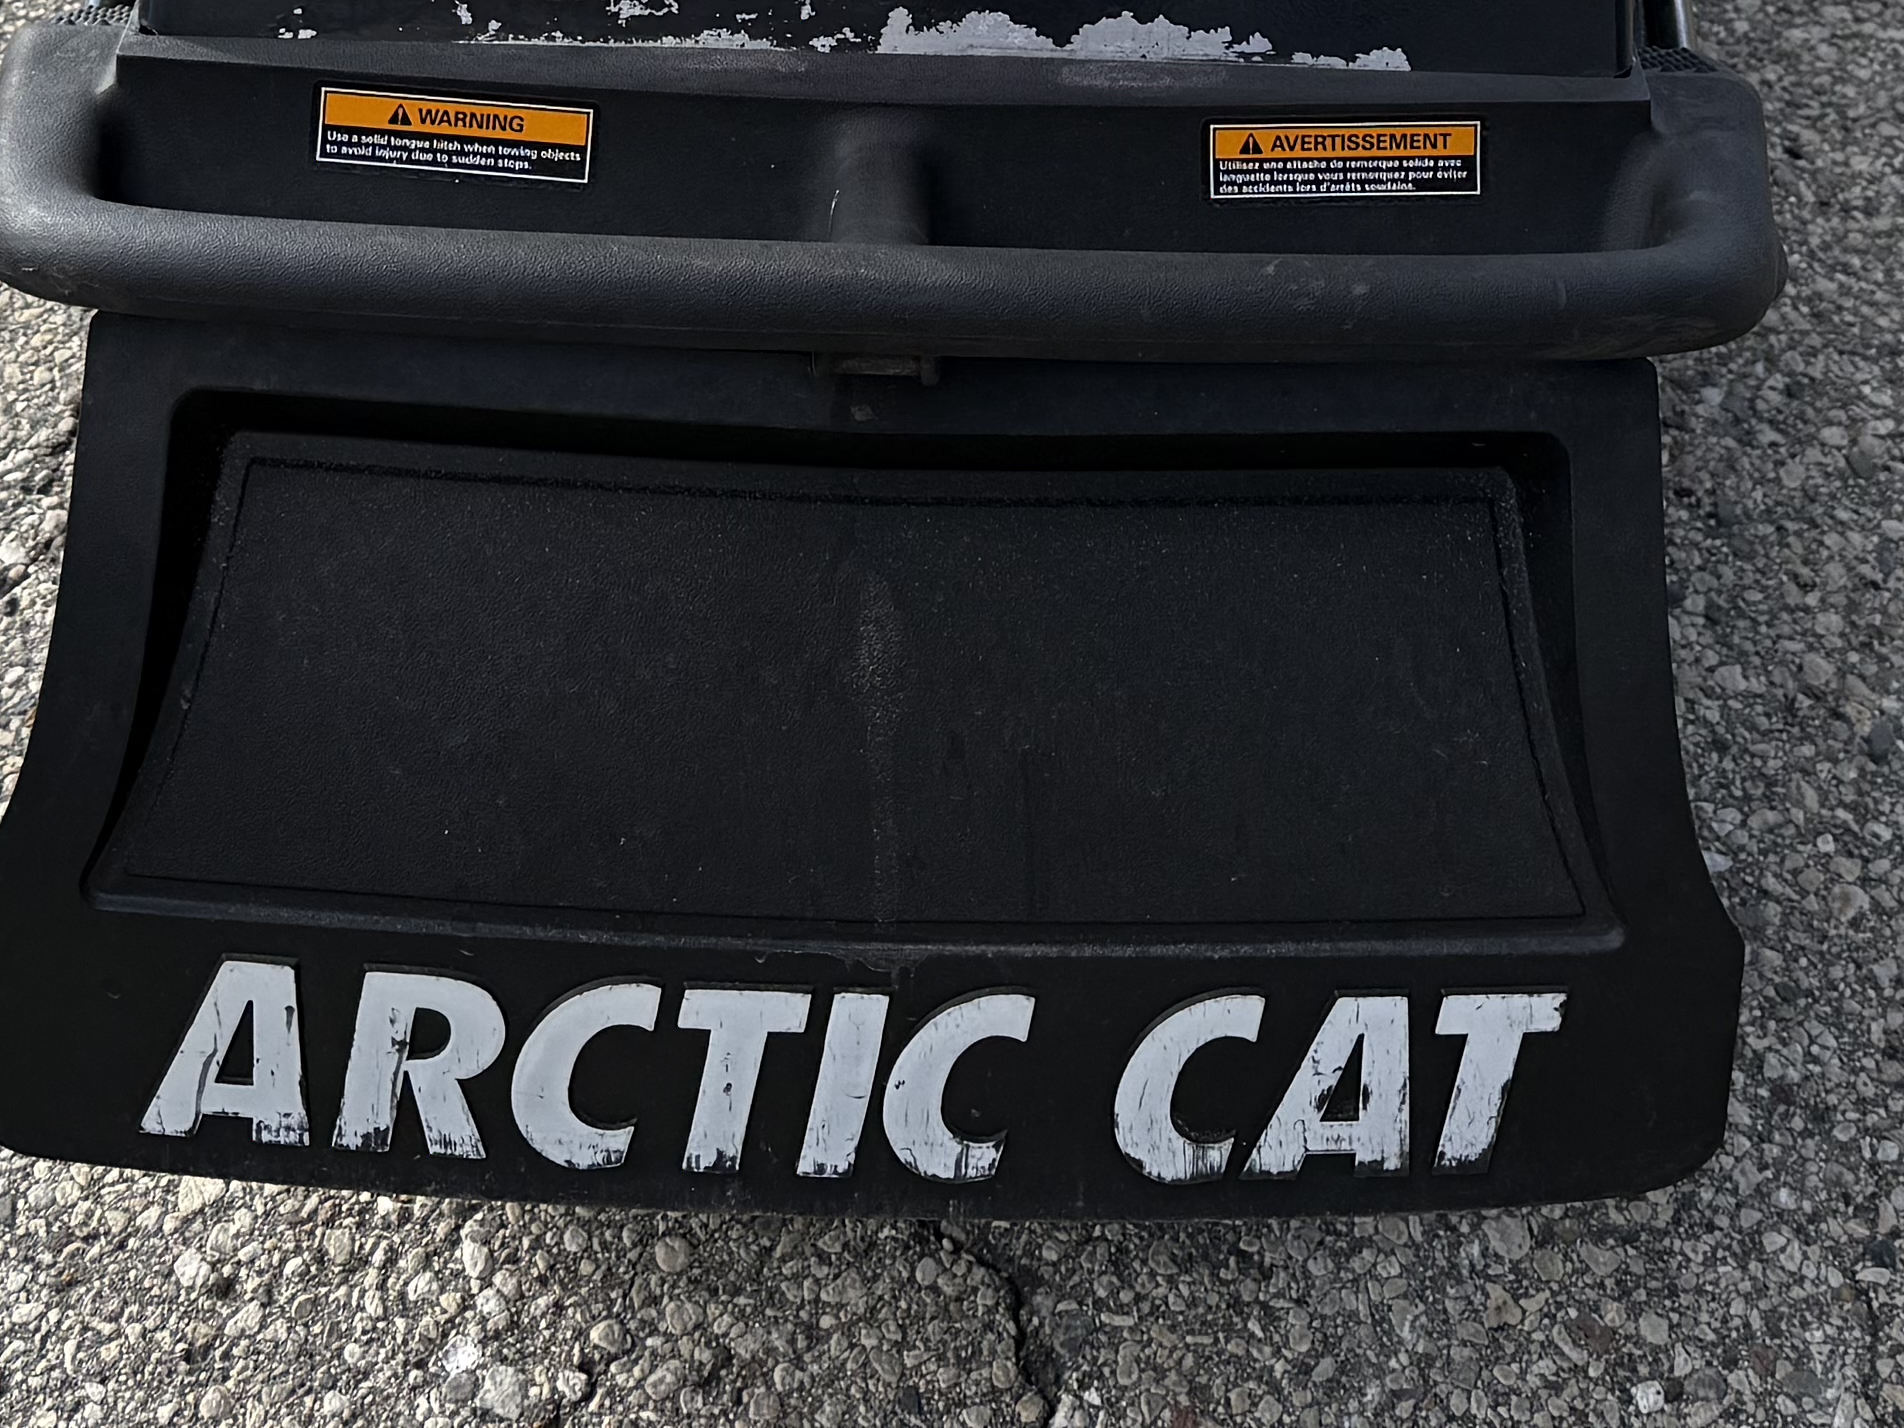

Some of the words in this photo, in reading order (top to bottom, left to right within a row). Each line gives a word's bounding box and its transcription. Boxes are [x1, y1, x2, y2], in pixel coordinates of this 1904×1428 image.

[418, 107, 525, 133] WARNING
[327, 130, 349, 142] Use
[352, 134, 358, 143] a
[361, 134, 388, 145] solid
[391, 136, 430, 149] tongue
[433, 139, 461, 151] hitch
[463, 142, 496, 154] when
[498, 145, 538, 160] towing
[540, 148, 581, 161] objects
[1270, 133, 1452, 152] AVERTISSEMENT
[326, 144, 338, 154] to
[341, 145, 372, 156] avoid
[375, 146, 409, 161] injury
[411, 149, 433, 161] due
[436, 152, 448, 163] to
[451, 154, 495, 166] sudden
[497, 158, 532, 170] stops.
[1219, 160, 1259, 170] Utilisez
[1263, 161, 1284, 169] une
[1330, 159, 1344, 169] de
[1346, 160, 1400, 170] remorque
[1402, 158, 1434, 167] solide
[1437, 159, 1462, 167] avec
[1219, 183, 1238, 193] des
[1242, 183, 1294, 193] accidents
[1296, 181, 1316, 192] lors
[1273, 171, 1315, 182] lorsque
[1317, 172, 1344, 181] vous
[1347, 171, 1406, 182] remorquez
[1408, 171, 1434, 181] pour
[139, 955, 1037, 1182] ARCTIC
[1113, 988, 1569, 1184] CAT
